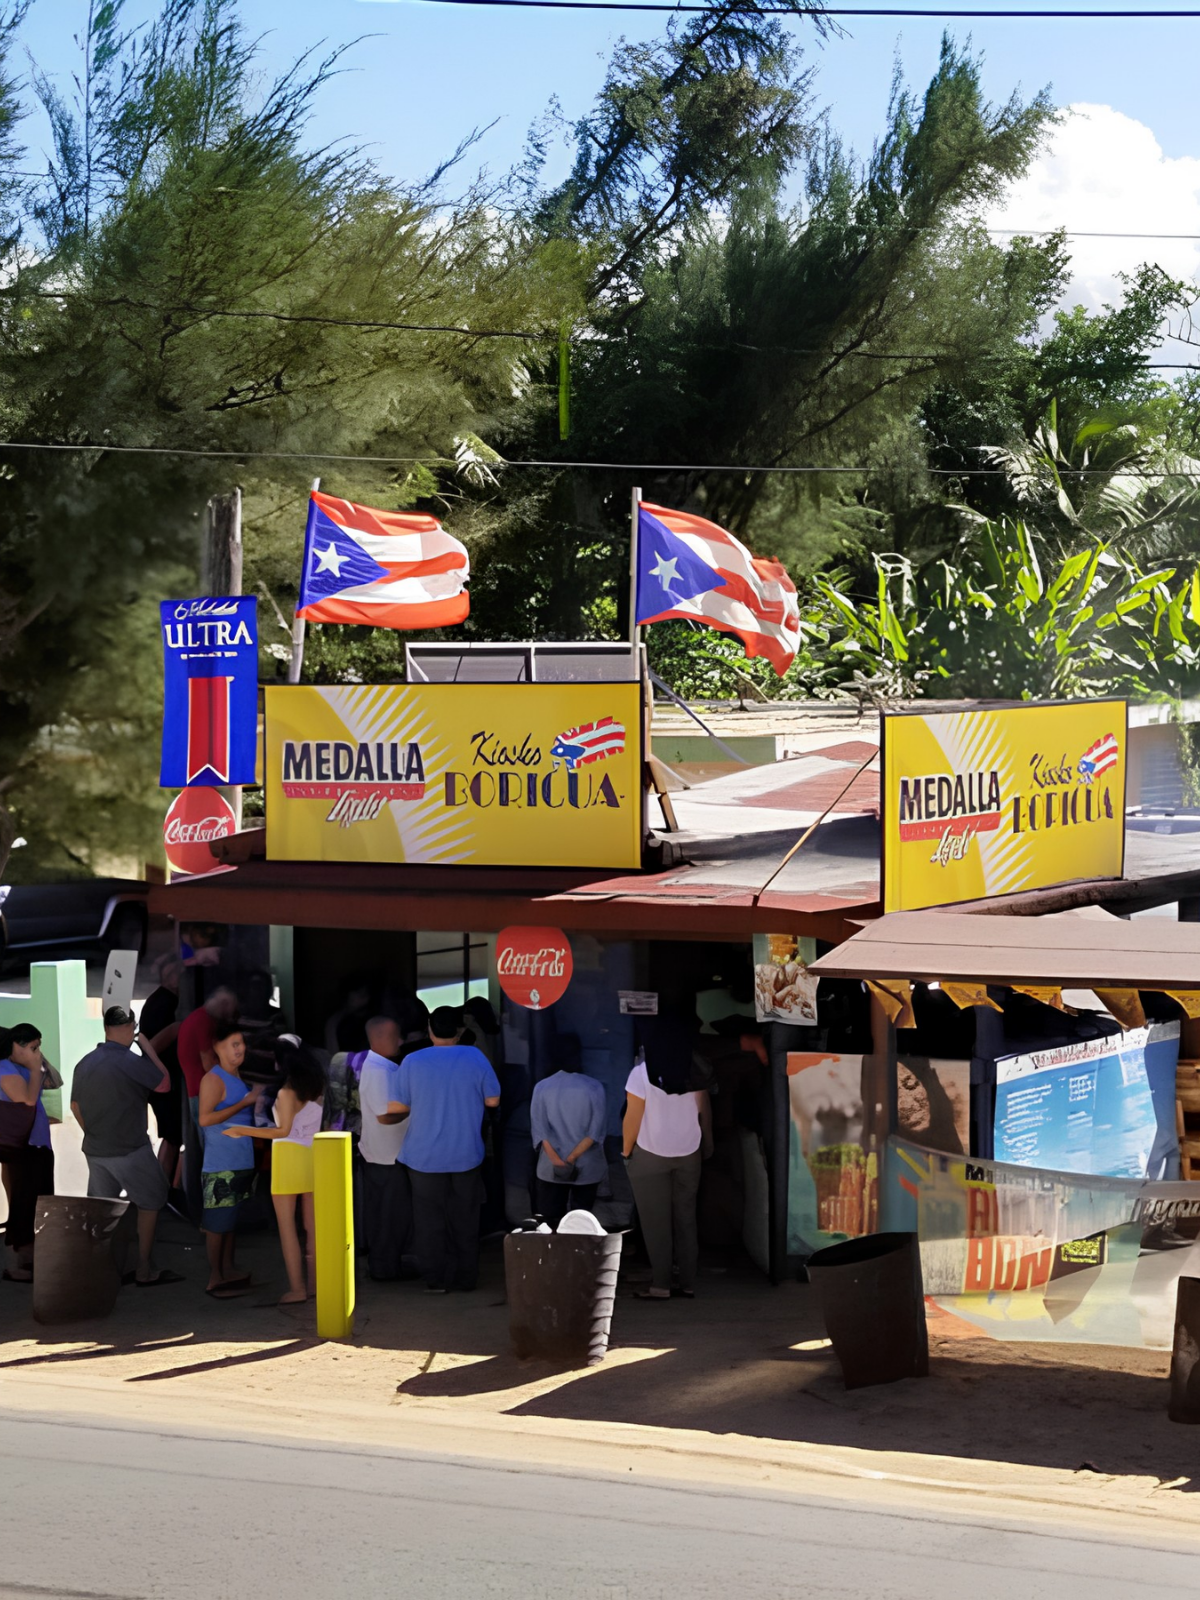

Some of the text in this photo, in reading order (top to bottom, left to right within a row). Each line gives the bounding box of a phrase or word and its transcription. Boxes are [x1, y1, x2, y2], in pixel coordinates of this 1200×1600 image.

[164, 620, 254, 648] ULTRA
[283, 741, 425, 782] MEDALLA
[444, 770, 621, 810] BORICUA
[899, 770, 1001, 821] MEDALLA
